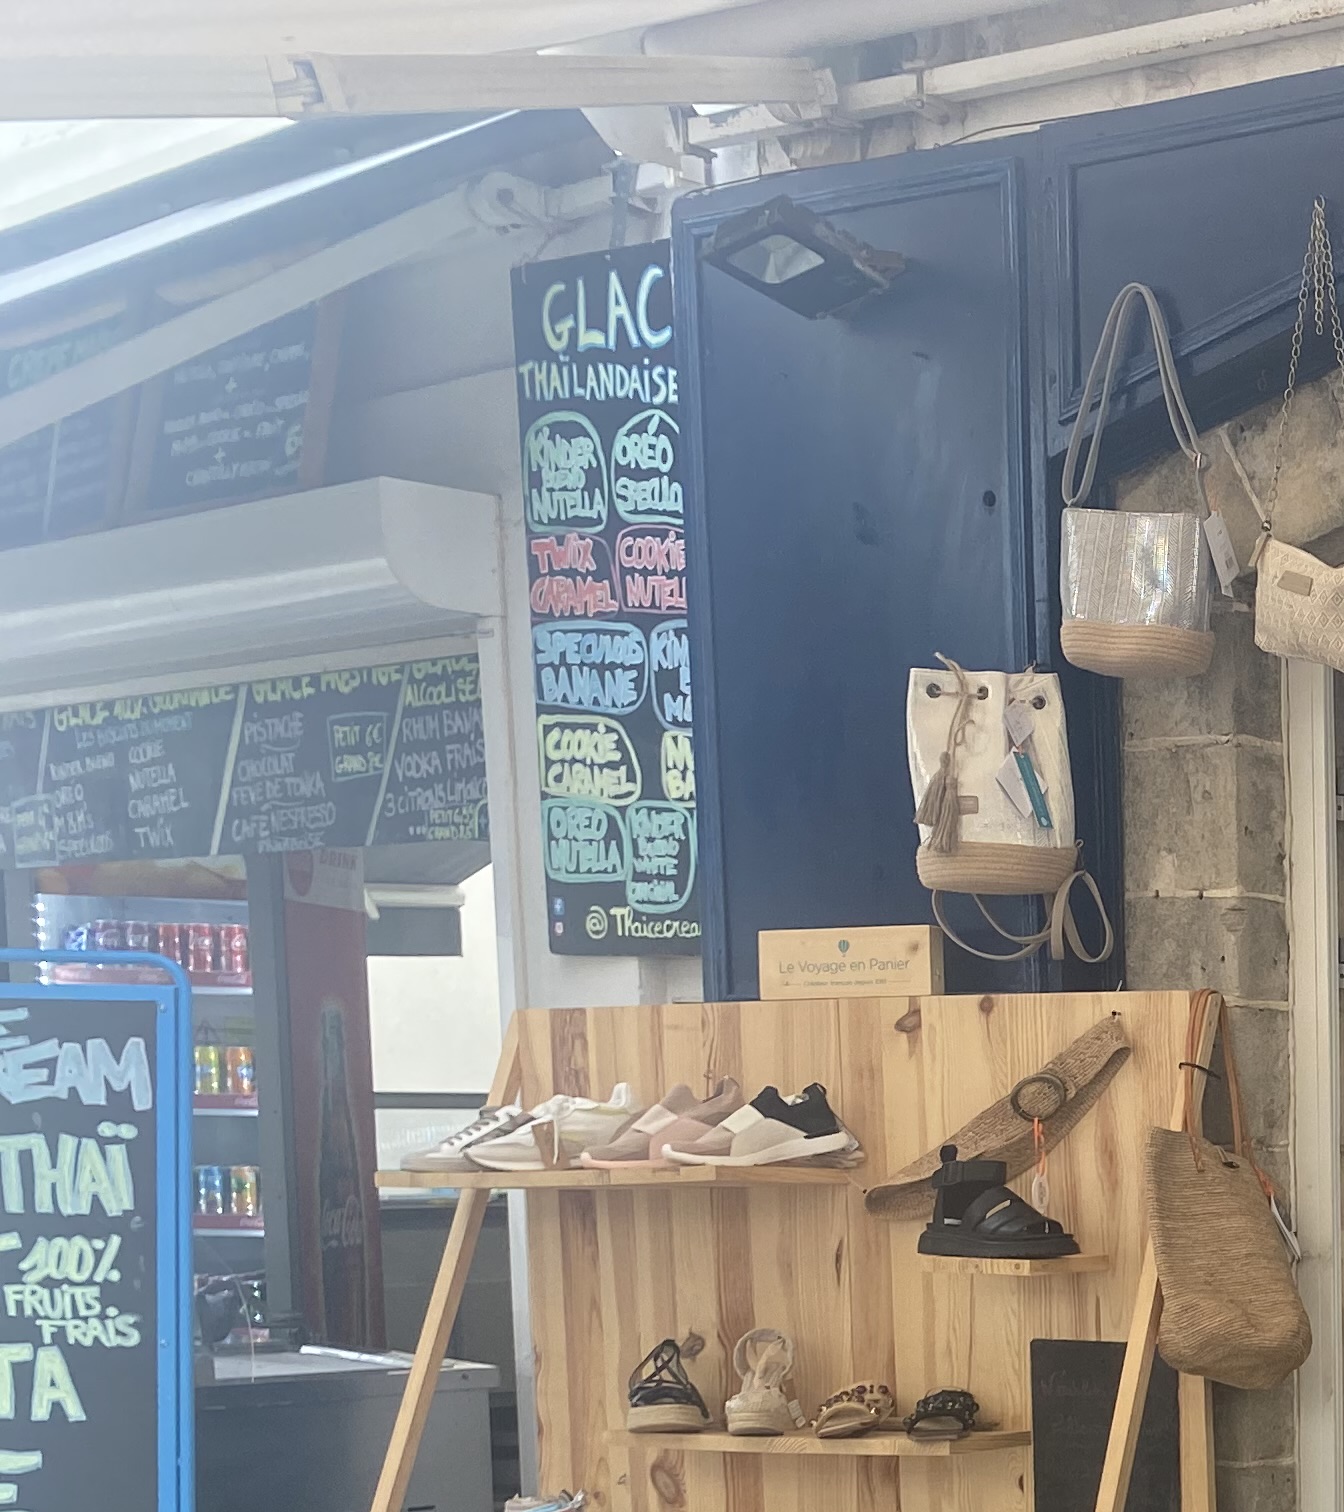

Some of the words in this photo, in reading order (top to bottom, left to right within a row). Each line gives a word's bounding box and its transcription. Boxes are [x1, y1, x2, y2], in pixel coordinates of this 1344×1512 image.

[542, 264, 672, 352] GLAC
[518, 354, 679, 405] THAÏLANDAISE
[532, 487, 605, 524] NUTELLA
[531, 532, 597, 574] TWIX
[620, 530, 685, 575] COOKIE
[531, 576, 619, 617] CARAMEL
[541, 666, 638, 708] BANANE
[333, 722, 361, 748] PETIT
[402, 713, 441, 744] RHUM
[546, 722, 622, 764] COOKIE
[128, 762, 177, 792] NUTELLA
[238, 752, 296, 782] CHOCOLAT
[395, 750, 443, 783] VODKA
[547, 762, 637, 798] CARAMEL
[128, 788, 190, 819] CARAMEL
[550, 806, 608, 841] OREO
[550, 838, 625, 874] NUTELLA
[779, 961, 795, 975] Le
[799, 959, 846, 976] Voyage
[850, 960, 866, 972] en
[869, 956, 911, 971] Panier
[0, 1121, 139, 1217] THAÏ
[18, 1233, 123, 1284] 100%
[3, 1283, 101, 1320] FRUITS
[35, 1306, 142, 1349] FRAIS
